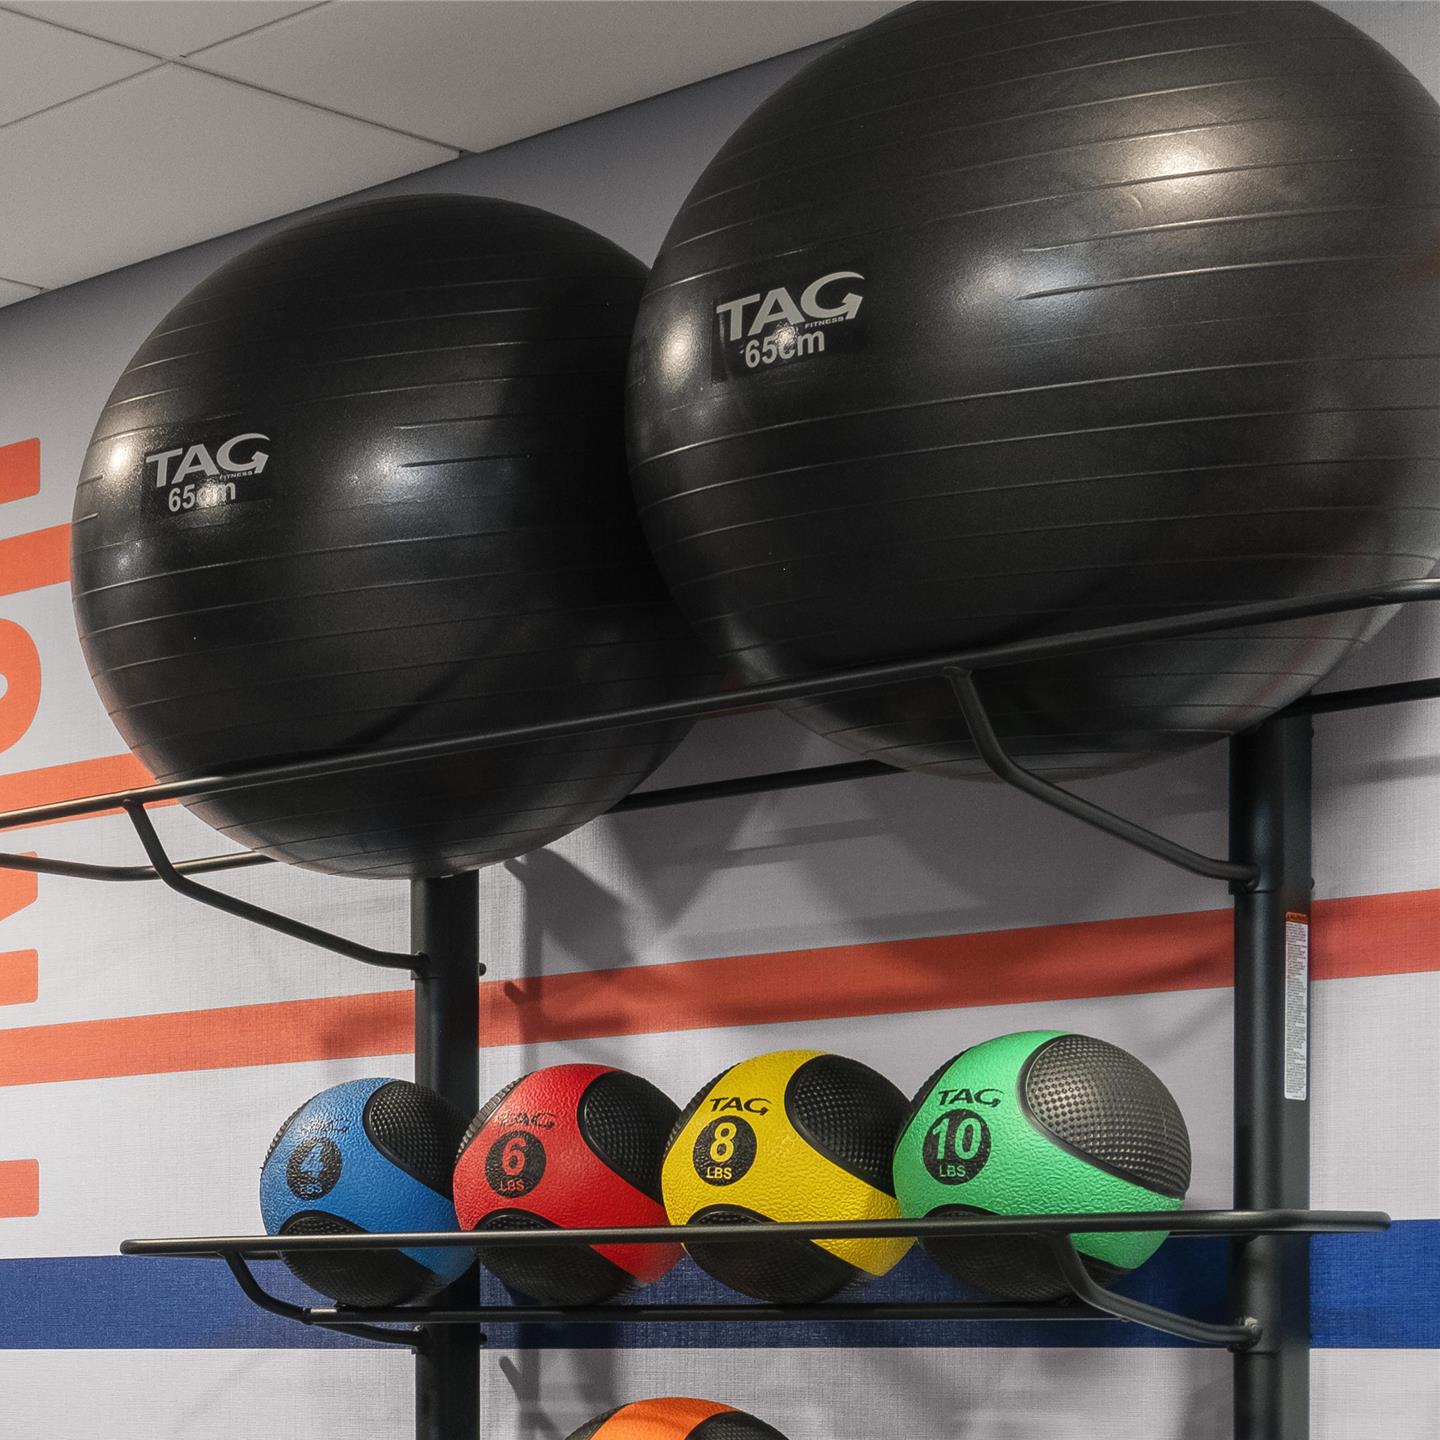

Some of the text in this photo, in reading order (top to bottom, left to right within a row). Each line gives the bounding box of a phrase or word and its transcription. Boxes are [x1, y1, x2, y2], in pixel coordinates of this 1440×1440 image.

[717, 271, 864, 341] TAG
[805, 317, 844, 328] FITNESS
[146, 433, 270, 487] TAG
[170, 481, 236, 512] 65m
[710, 1096, 772, 1116] TAG
[937, 1088, 1004, 1107] TAG
[710, 1121, 737, 1163] 8
[932, 1116, 983, 1161] 10
[300, 1143, 324, 1178] 4
[502, 1137, 526, 1176] 6
[939, 1165, 966, 1178] LBS
[499, 1180, 525, 1192] LBS
[706, 1166, 732, 1180] LBS
